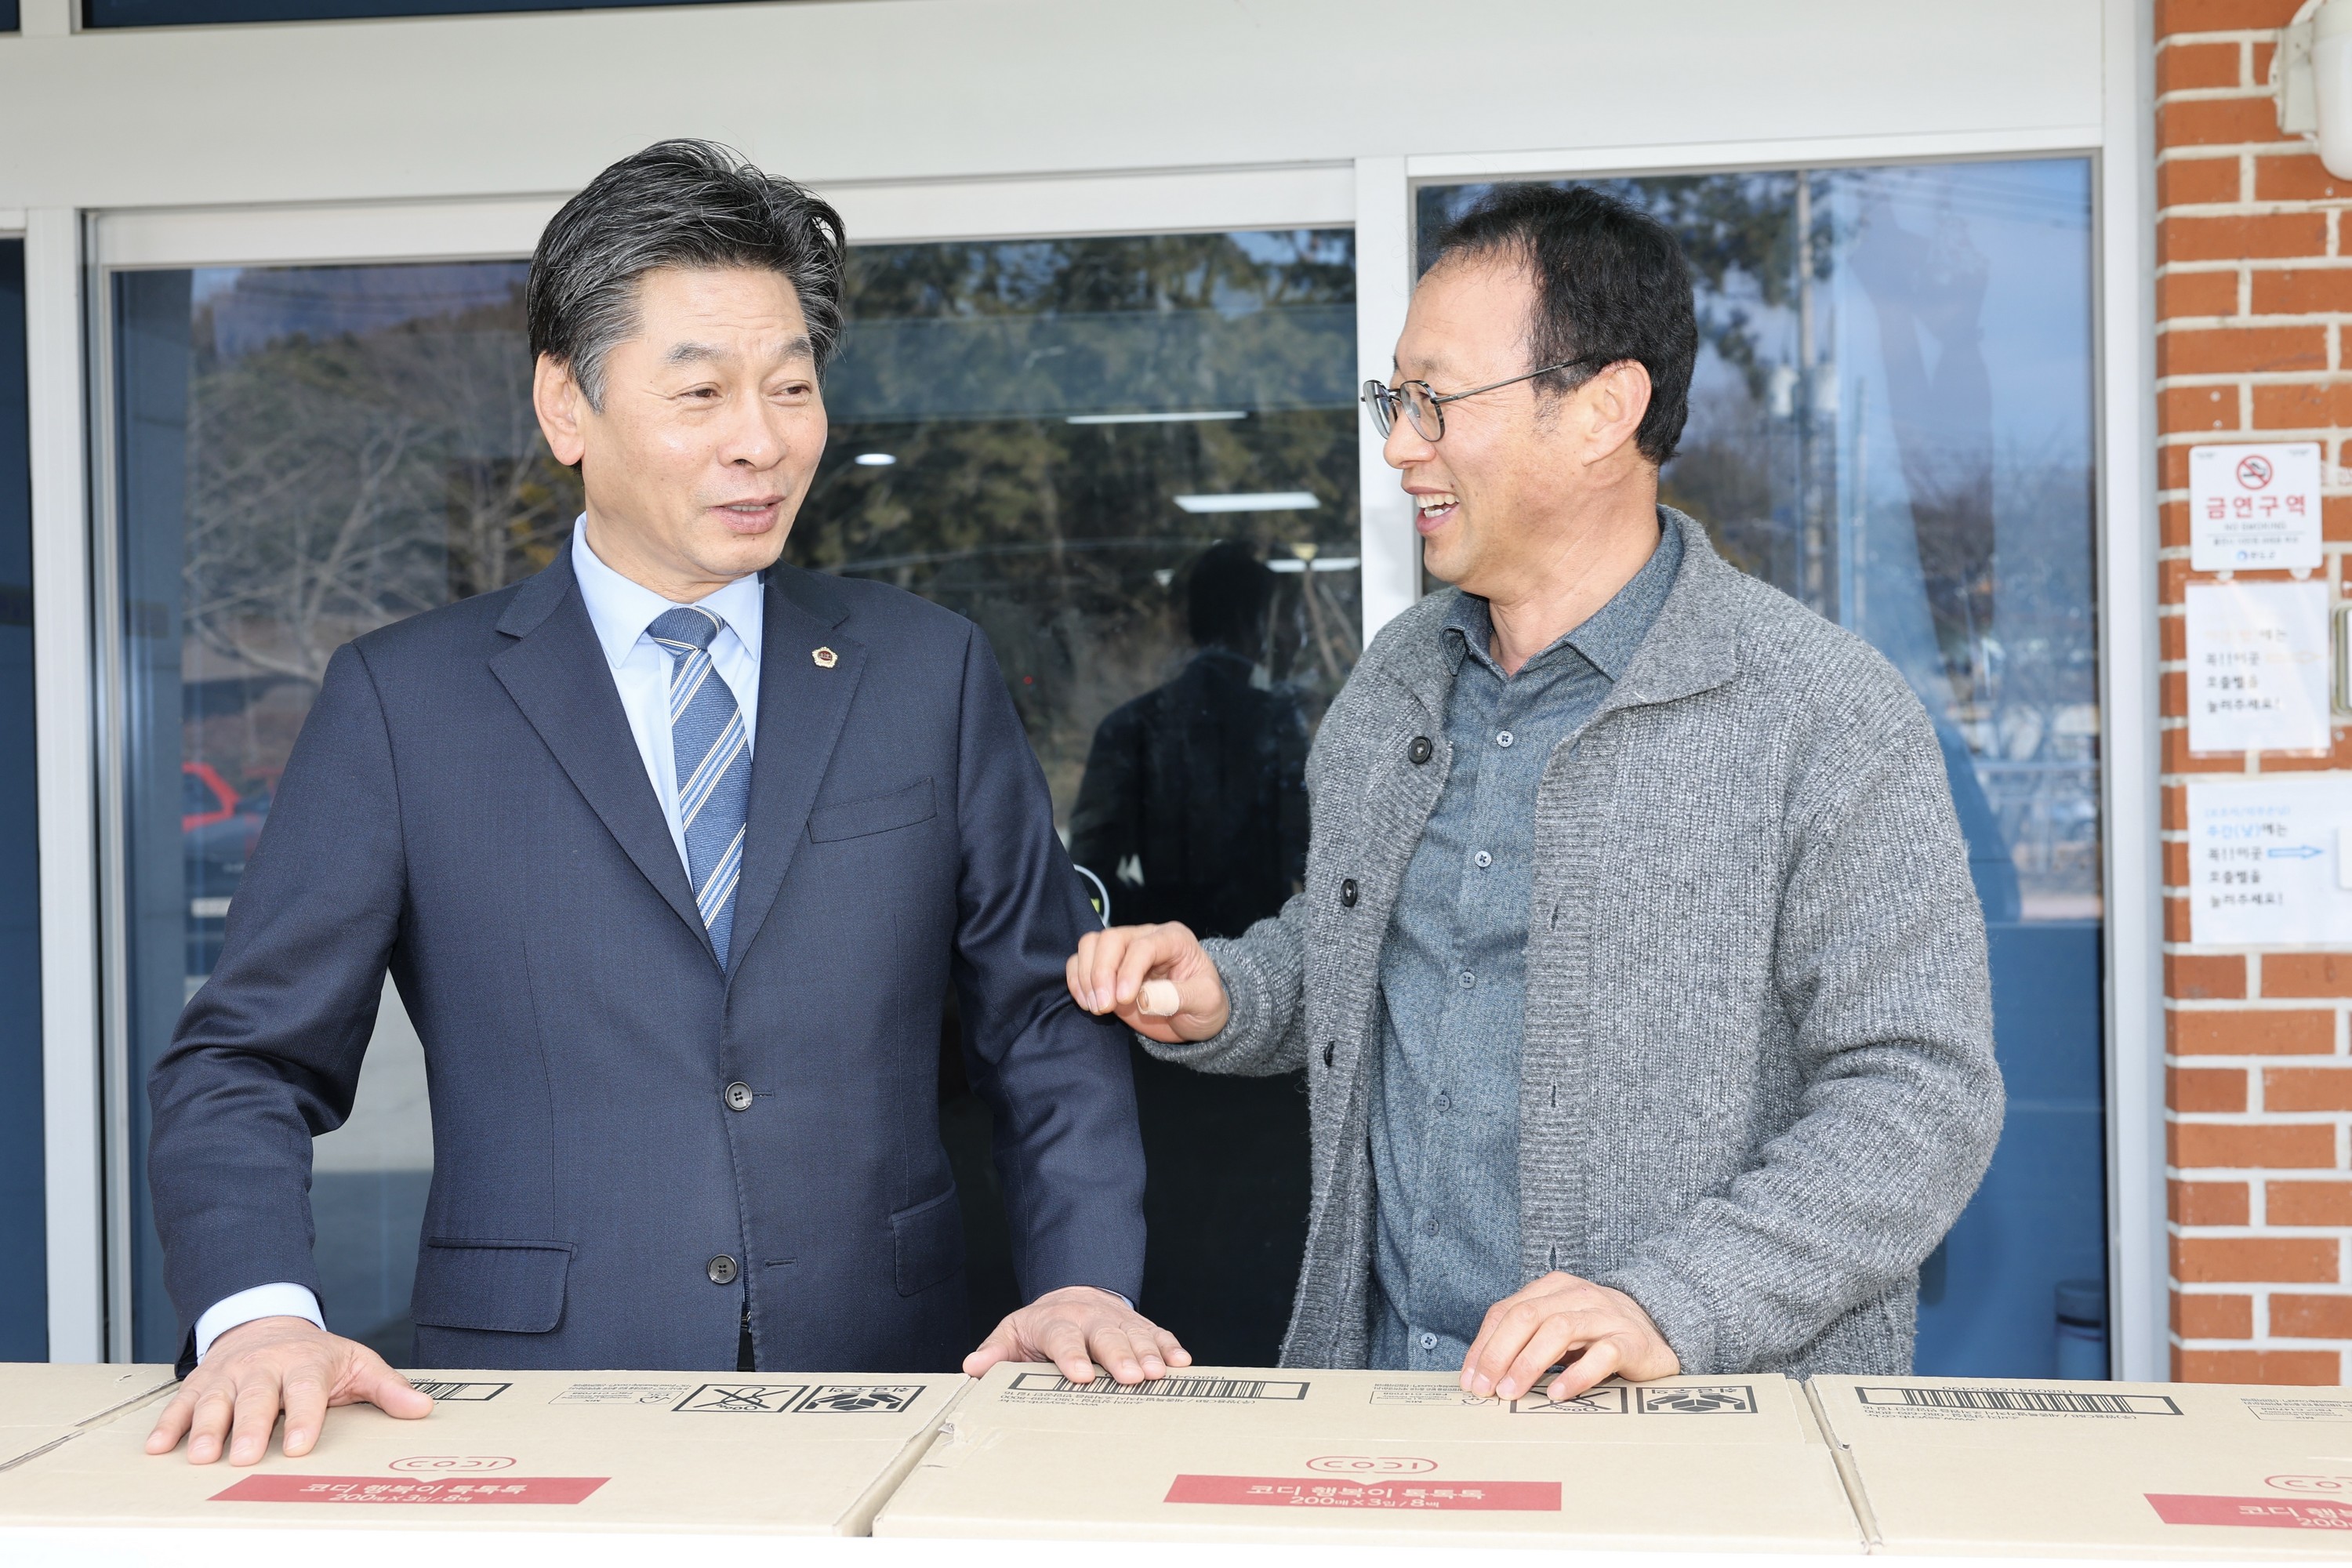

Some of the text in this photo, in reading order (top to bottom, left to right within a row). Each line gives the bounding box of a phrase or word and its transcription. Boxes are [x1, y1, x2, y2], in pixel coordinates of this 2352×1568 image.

[2207, 495, 2305, 519] 금연구역
[1323, 1461, 1418, 1469] CODI
[299, 1483, 358, 1494] 코디
[363, 1484, 444, 1494] 행복이
[2284, 1480, 2352, 1489] CO
[1247, 1485, 1486, 1500] 코디 행복이 톡톡톡
[2238, 1505, 2300, 1518] 코디
